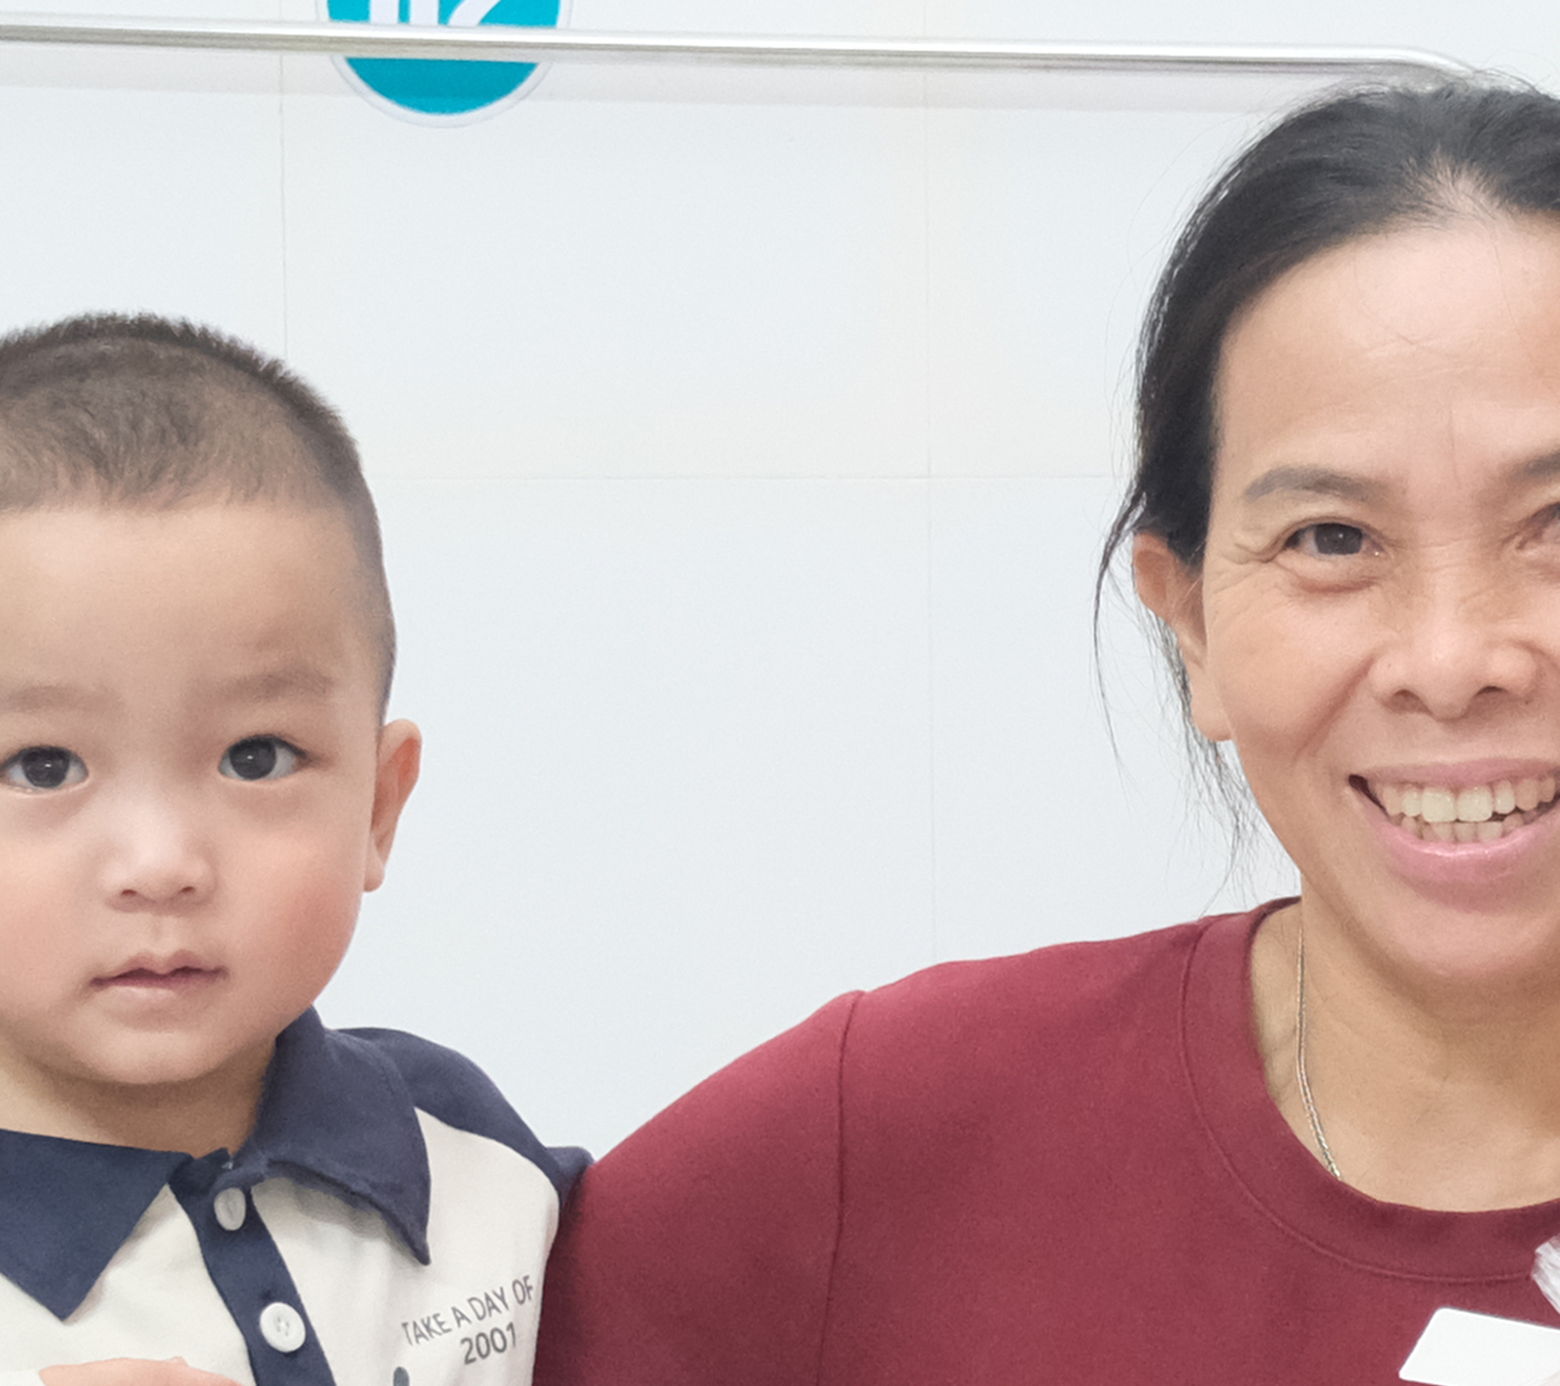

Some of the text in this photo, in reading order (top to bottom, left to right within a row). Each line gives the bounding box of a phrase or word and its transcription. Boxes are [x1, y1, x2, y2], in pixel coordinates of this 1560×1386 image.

[401, 1312, 452, 1346] TAKE
[451, 1306, 472, 1329] A
[467, 1286, 509, 1321] DAY
[460, 1321, 517, 1365] 2001
